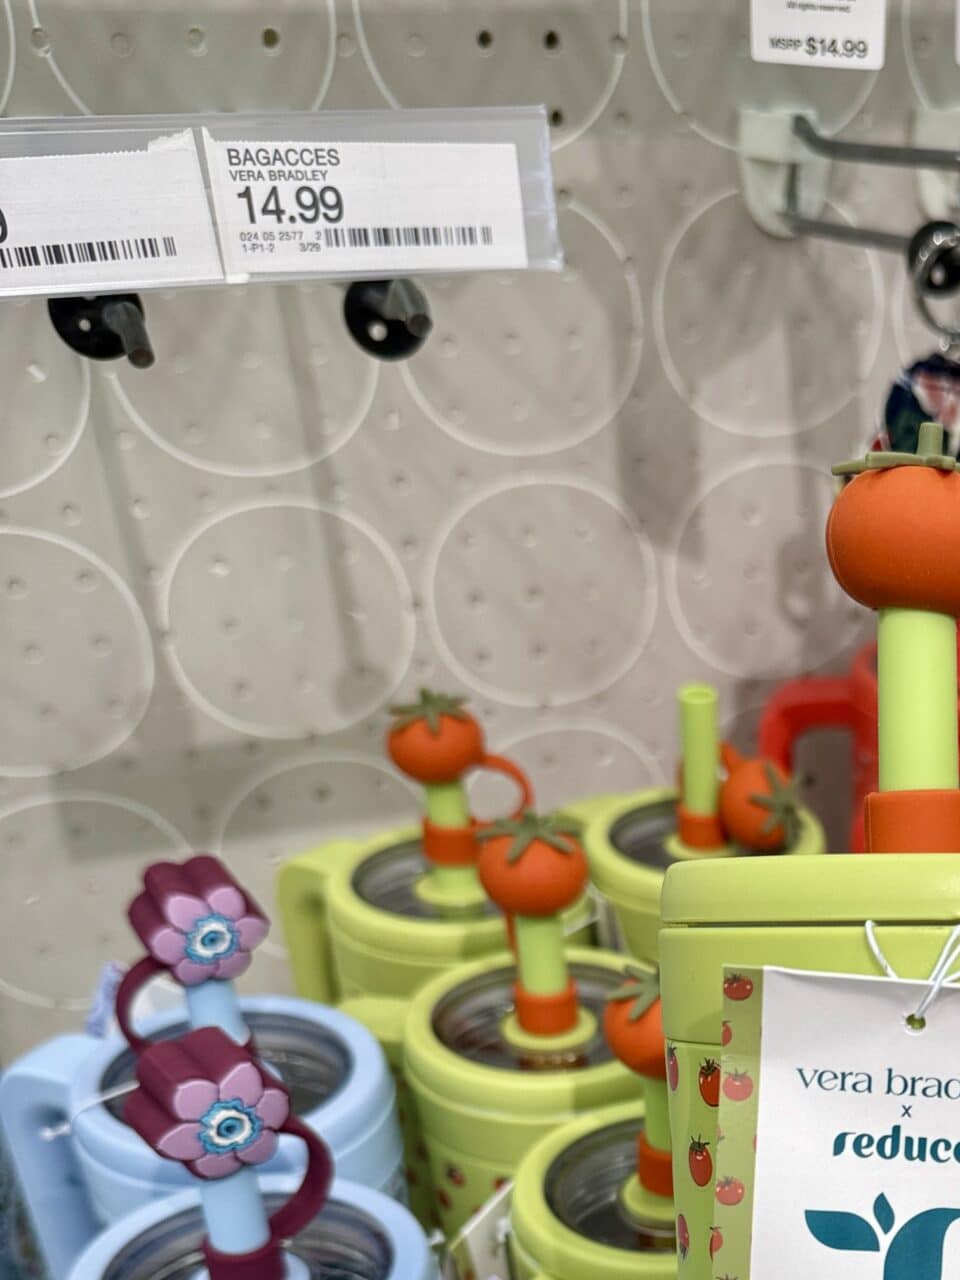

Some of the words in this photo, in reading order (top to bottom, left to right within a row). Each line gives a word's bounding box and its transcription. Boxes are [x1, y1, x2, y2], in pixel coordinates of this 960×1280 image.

[805, 36, 868, 58] $14.99
[227, 148, 341, 166] BAGACCES
[229, 170, 265, 181] VERA
[268, 170, 328, 181] BRADLEY
[237, 185, 344, 224] 14.99
[240, 232, 259, 241] 024
[263, 232, 275, 241] 05
[796, 1067, 872, 1095] vera
[901, 1104, 912, 1118] x
